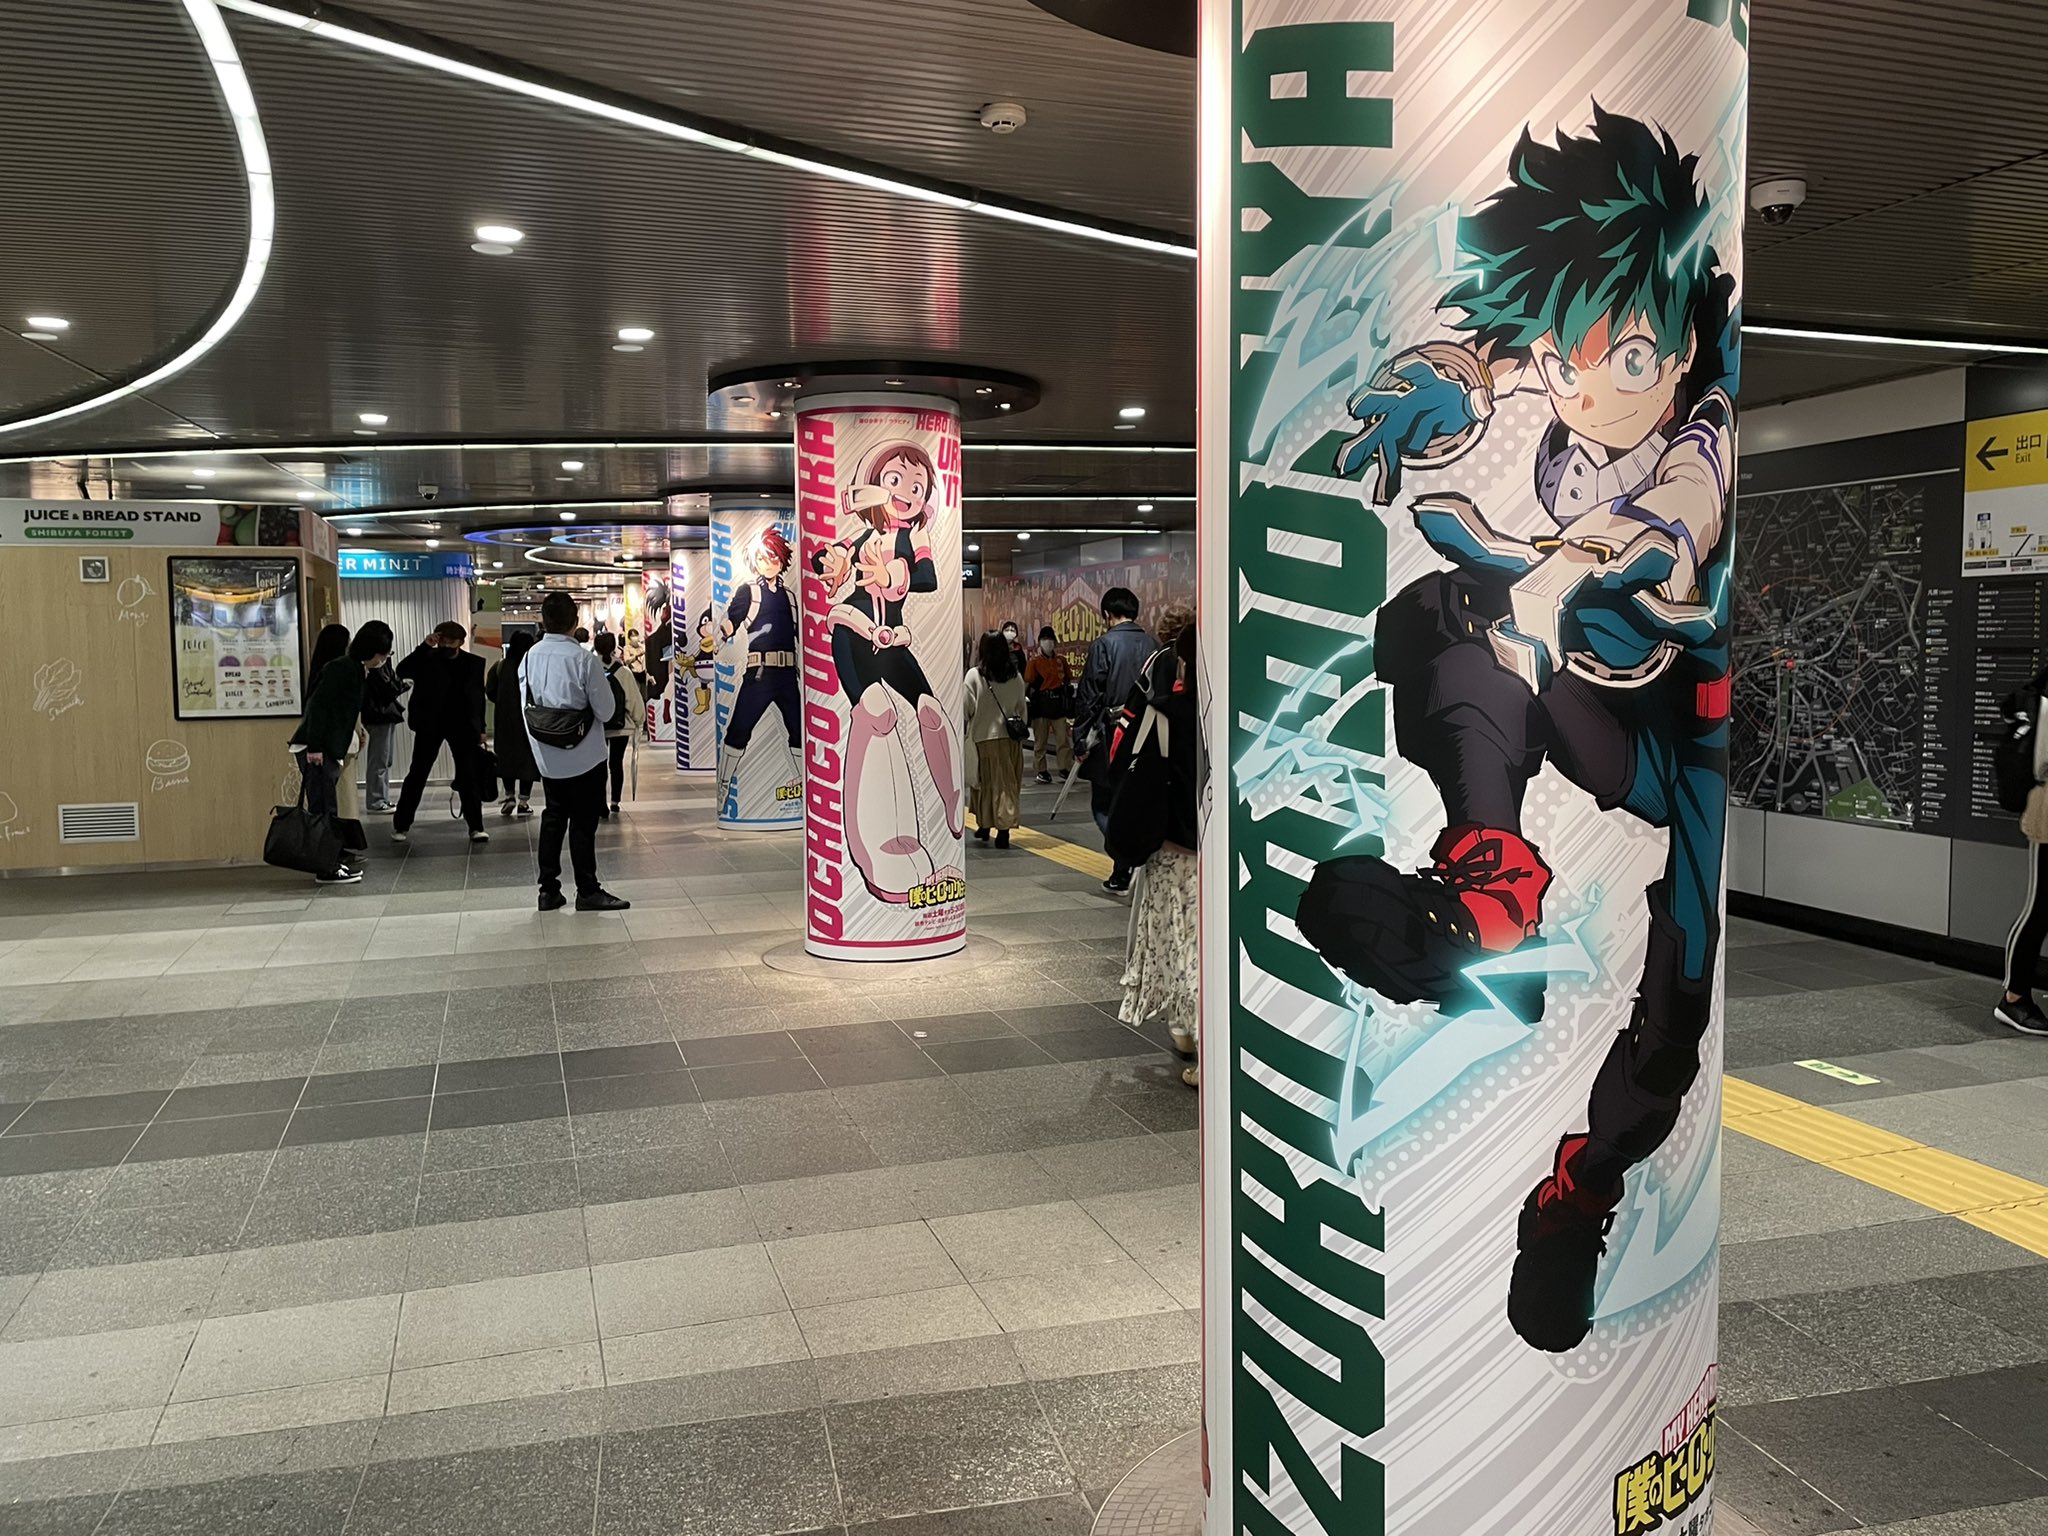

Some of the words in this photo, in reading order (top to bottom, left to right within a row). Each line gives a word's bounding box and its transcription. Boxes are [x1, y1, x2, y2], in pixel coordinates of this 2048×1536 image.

[916, 413, 951, 434] HERO
[2016, 434, 2042, 451] 出口
[2015, 453, 2032, 464] Exit
[24, 510, 69, 523] JUICE
[83, 511, 139, 522] BREAD
[143, 511, 201, 522] STAND
[31, 529, 82, 537] SHIBUYA
[85, 530, 128, 538] FOREST
[363, 558, 422, 571] MINIT
[804, 700, 844, 941] OCHACO
[1231, 1005, 1387, 1536] ZUKU
[1664, 1409, 1686, 1456] MY
